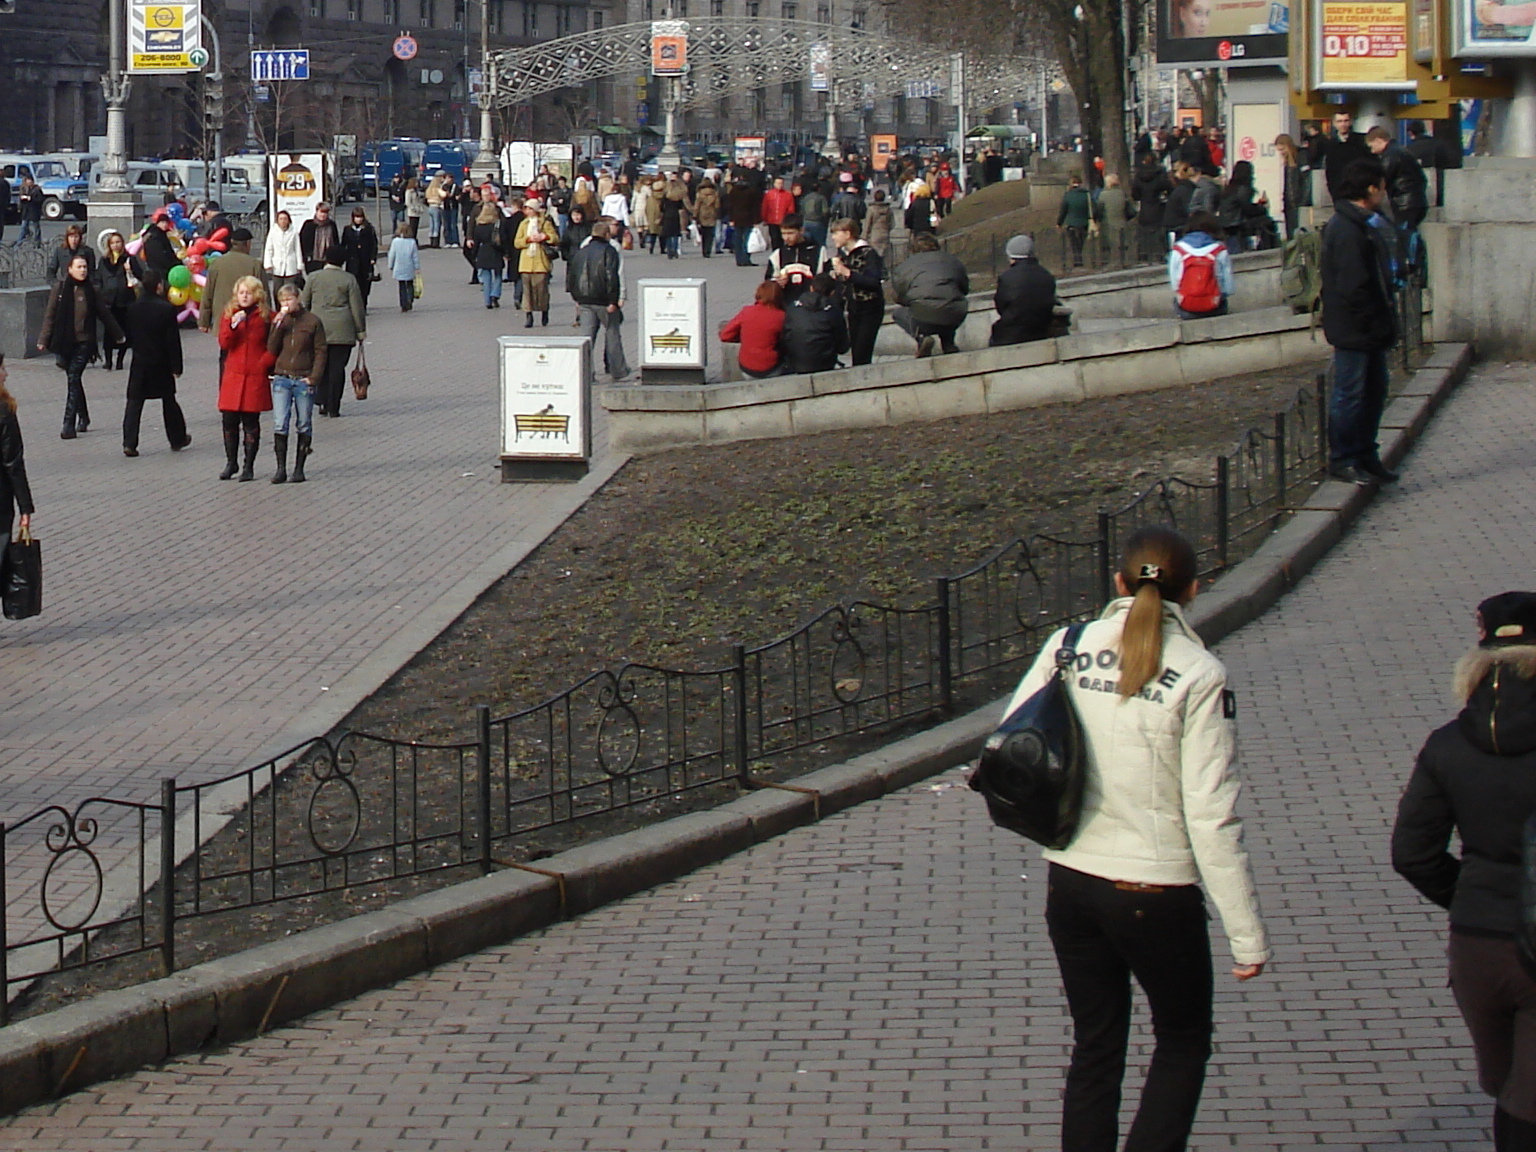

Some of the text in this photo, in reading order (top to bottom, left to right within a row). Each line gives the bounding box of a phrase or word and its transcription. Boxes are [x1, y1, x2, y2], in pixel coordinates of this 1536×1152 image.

[1232, 44, 1245, 56] LG
[1325, 35, 1370, 58] 0,10
[1261, 143, 1276, 157] LG
[286, 174, 305, 190] 29
